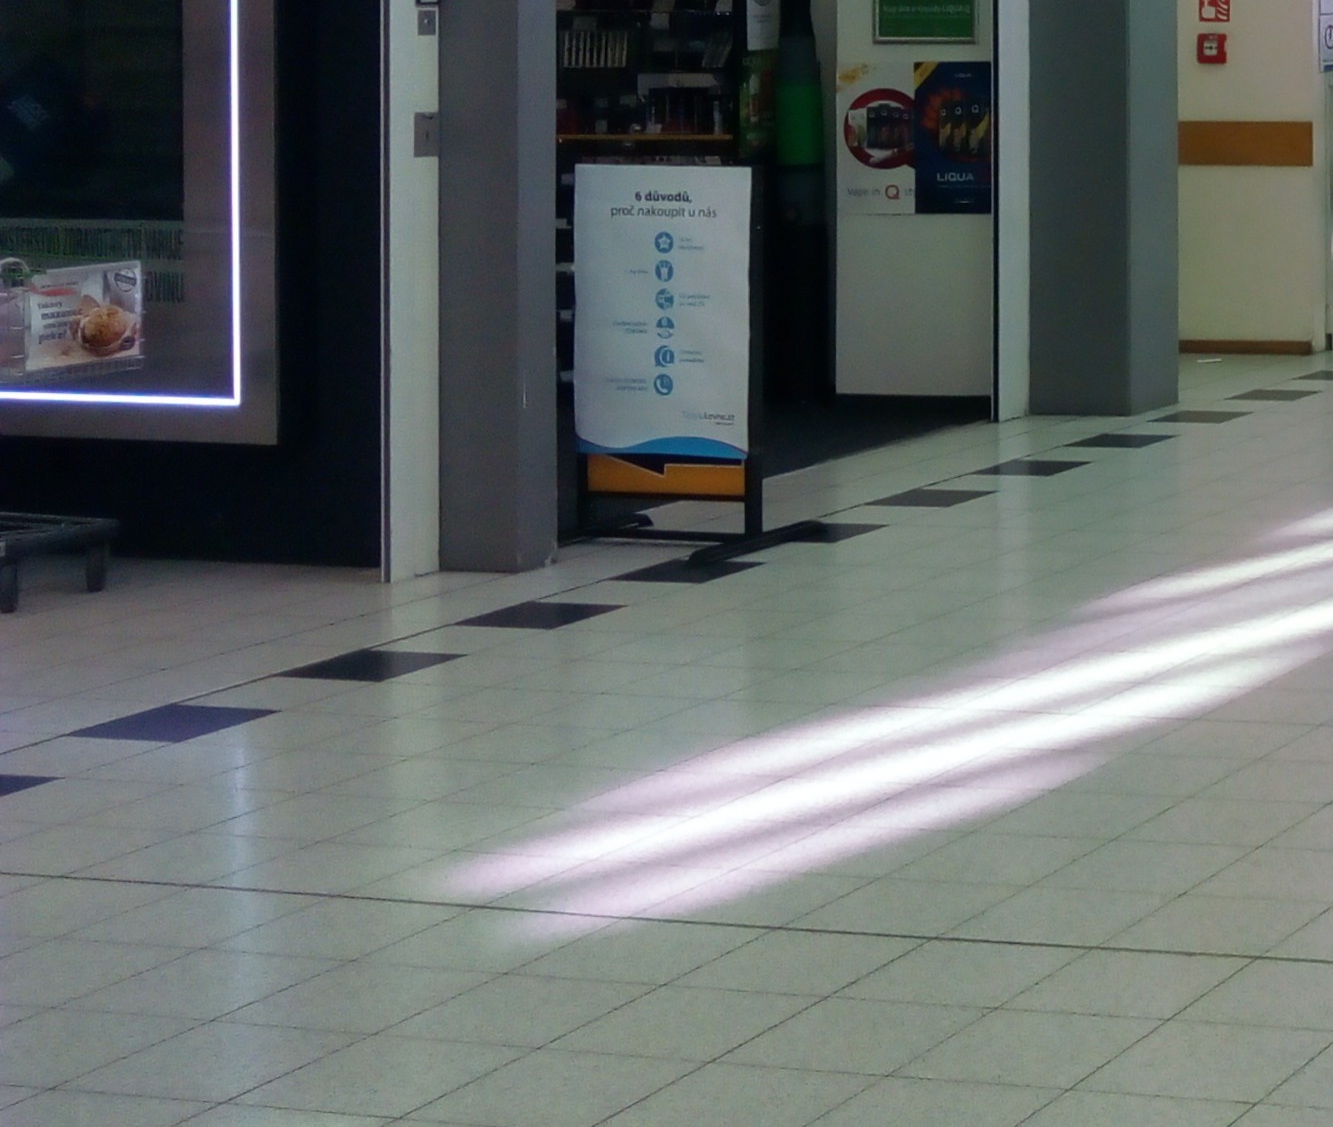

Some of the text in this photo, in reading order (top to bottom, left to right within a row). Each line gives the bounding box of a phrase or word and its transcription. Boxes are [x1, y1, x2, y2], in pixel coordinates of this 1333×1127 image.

[936, 172, 974, 182] LIQUA
[634, 190, 693, 204] 6 důvodů,
[610, 205, 718, 219] proč nakoupit u nás
